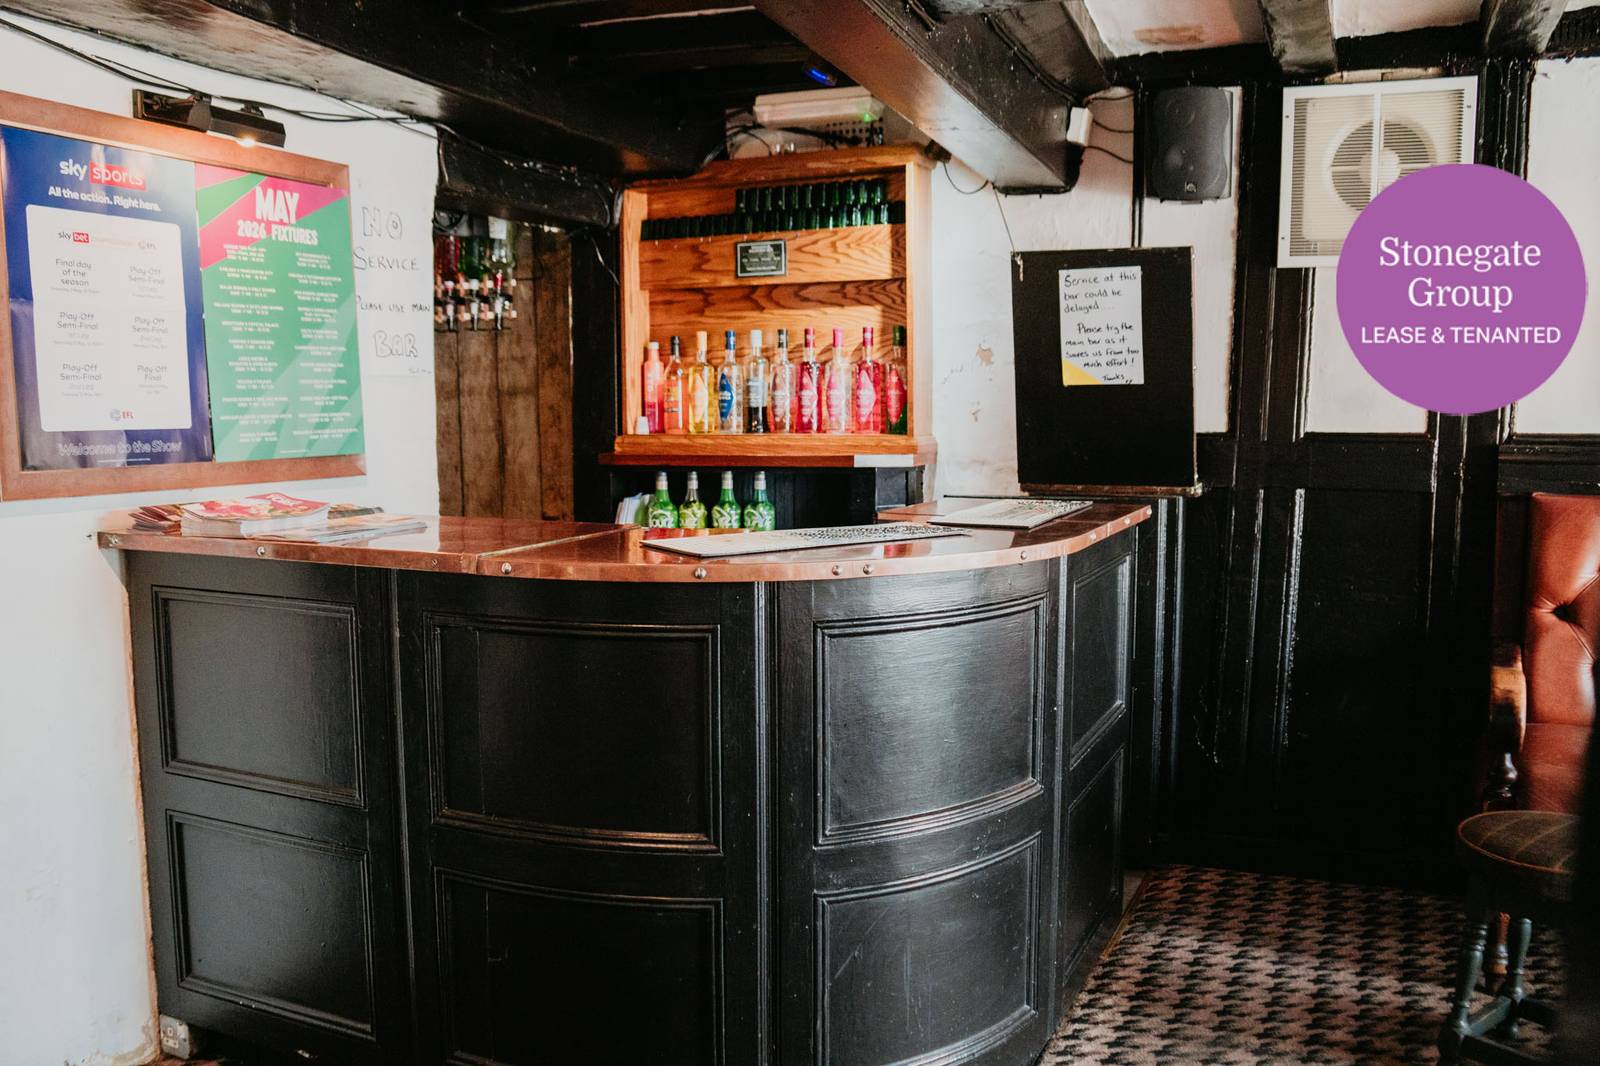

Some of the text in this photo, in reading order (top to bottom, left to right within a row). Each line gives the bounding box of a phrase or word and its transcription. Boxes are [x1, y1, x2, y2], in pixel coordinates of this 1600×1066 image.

[59, 158, 145, 187] sky sports
[48, 186, 161, 212] All the action. Right here.
[255, 186, 300, 224] MAY
[361, 206, 403, 241] NO
[58, 230, 72, 242] sky
[74, 232, 89, 243] bet
[271, 223, 319, 246] FIXTURES
[56, 257, 92, 271] Final day
[62, 268, 86, 278] of the
[1104, 274, 1113, 282] at
[1120, 271, 1137, 281] this
[60, 278, 89, 287] season
[1084, 289, 1108, 298] could
[412, 303, 431, 313] MAIN
[59, 312, 95, 322] Play-Off
[56, 321, 99, 330] Semi-Final
[1077, 323, 1133, 335] Please try the
[373, 329, 418, 358] BAR
[62, 363, 98, 374] Play-Off
[60, 372, 102, 382] Semi-Final
[117, 441, 132, 454] to
[132, 440, 151, 453] the
[152, 439, 182, 453] Show
